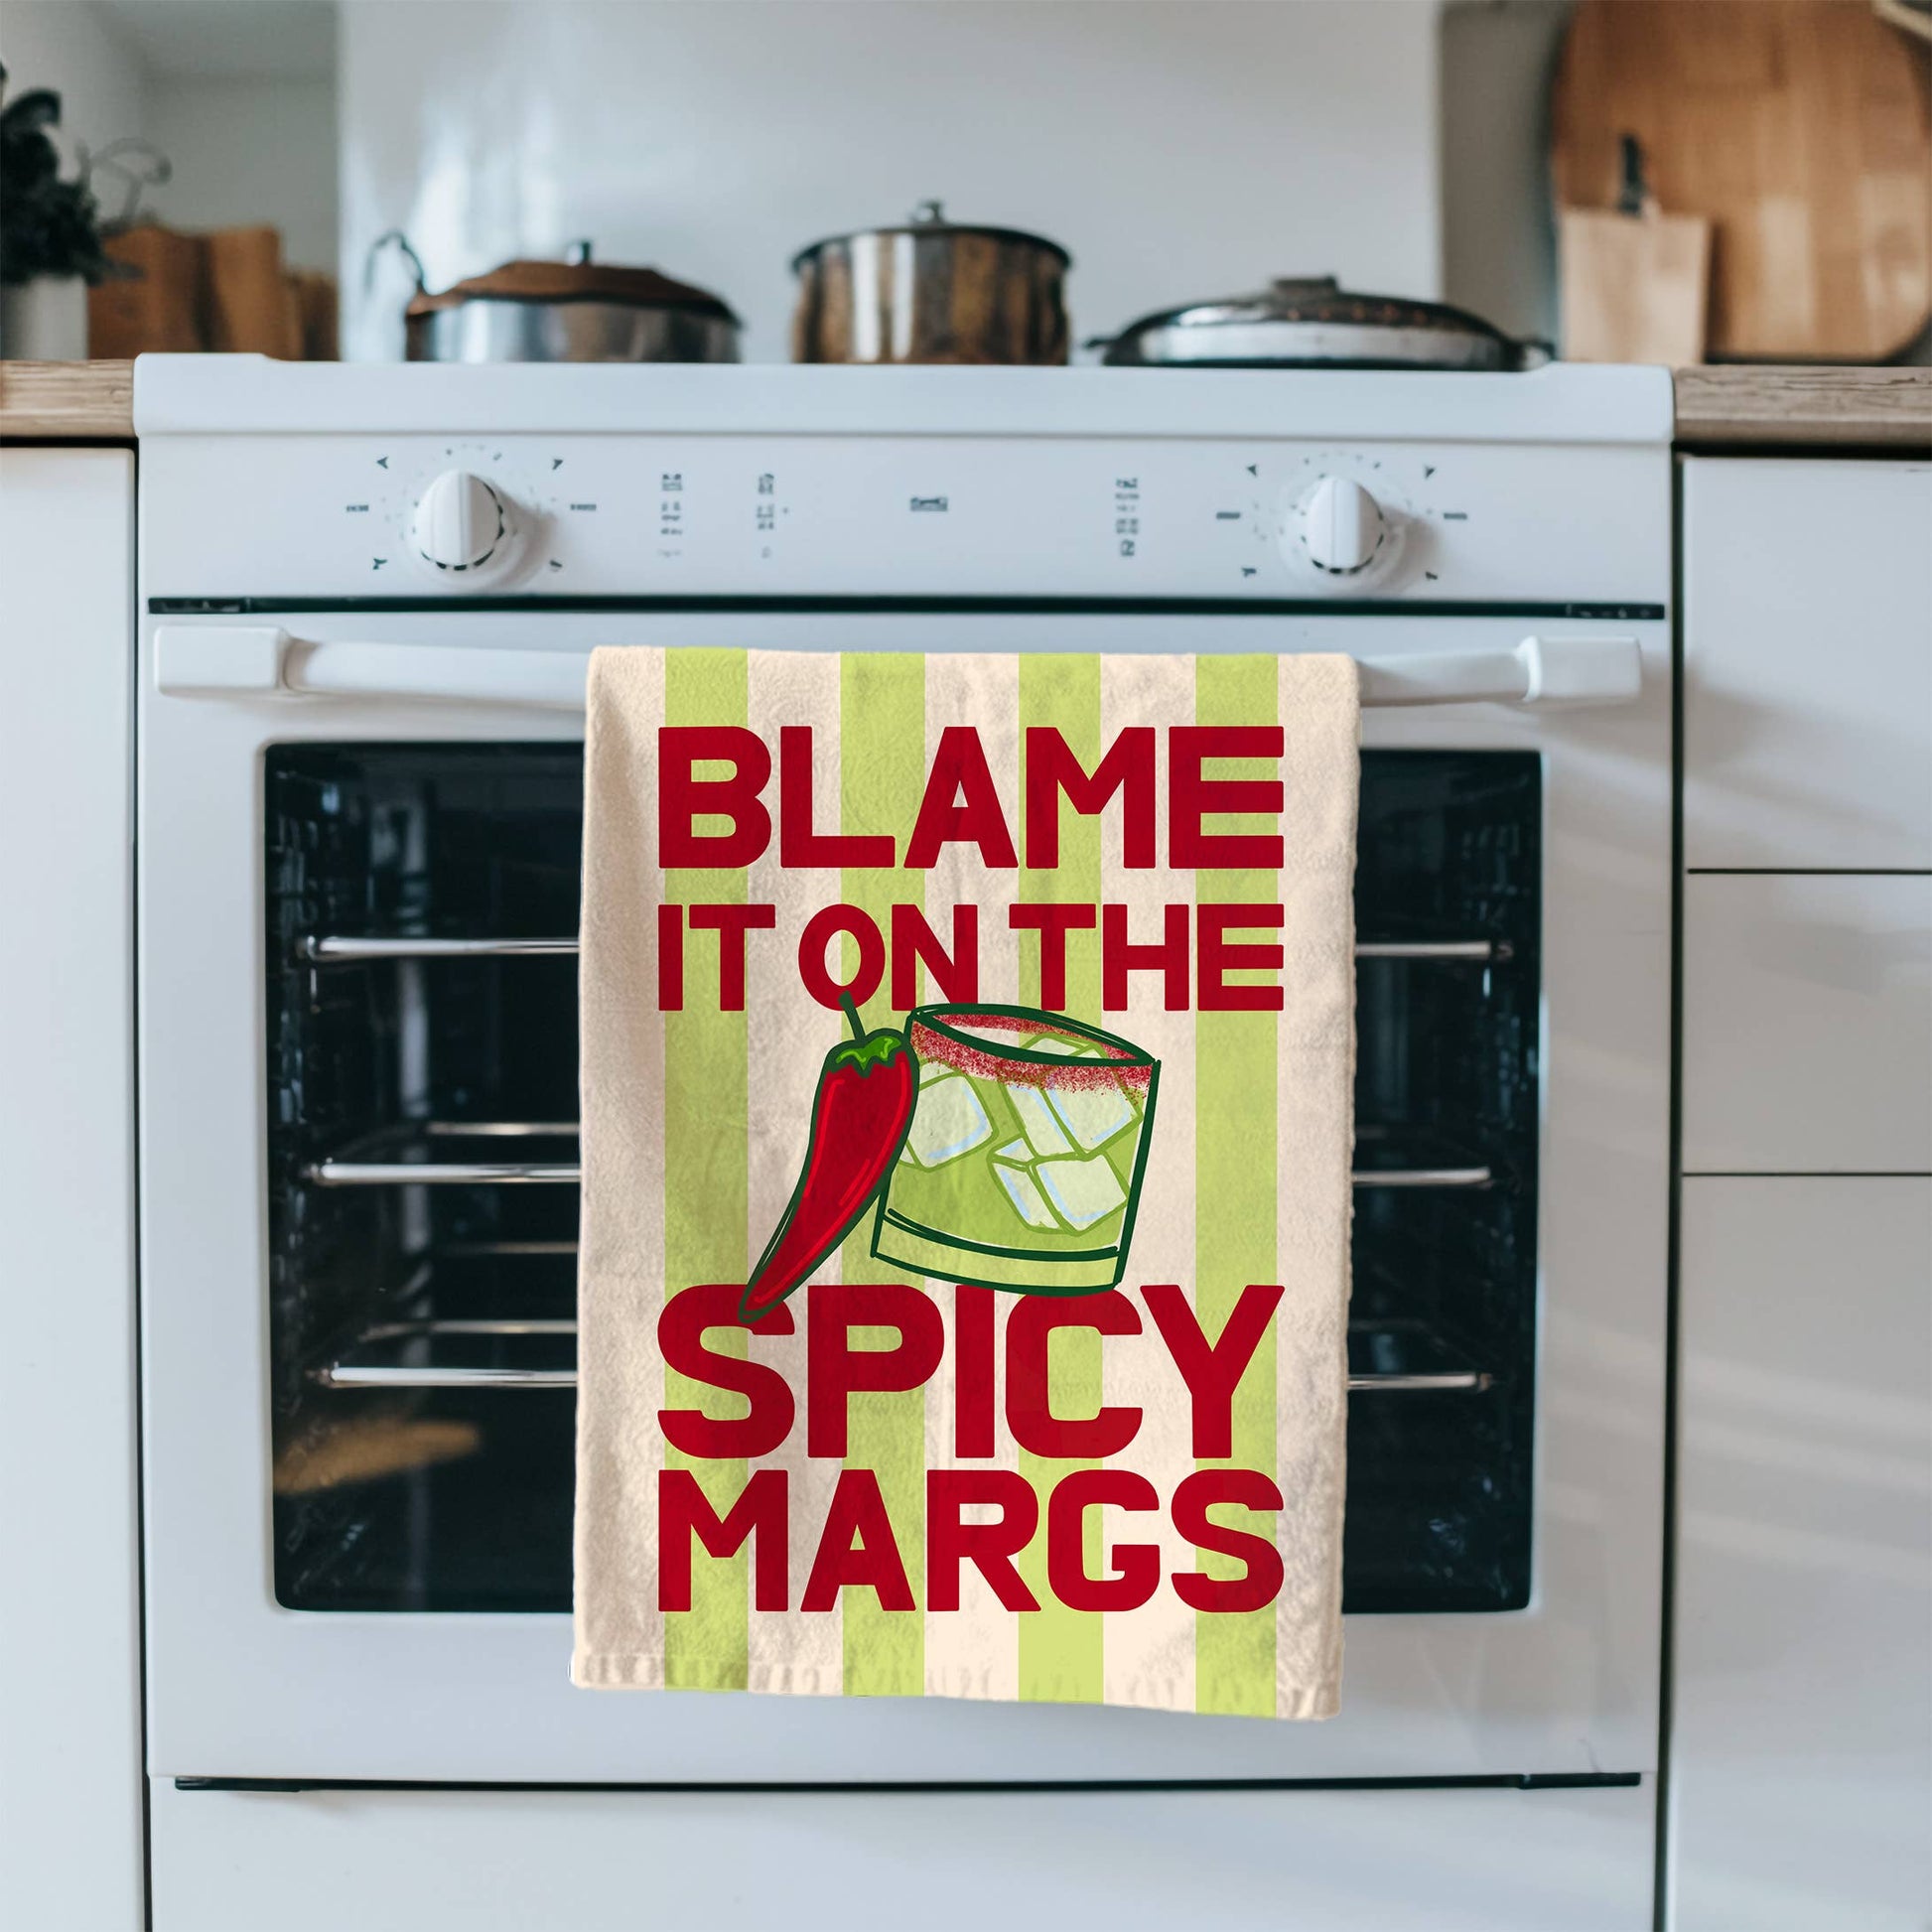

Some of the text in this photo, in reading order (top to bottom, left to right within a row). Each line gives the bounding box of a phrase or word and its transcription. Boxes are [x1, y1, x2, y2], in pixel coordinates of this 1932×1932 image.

[658, 726, 1285, 870] BLAME
[657, 903, 1285, 1012] IT ON THE
[657, 1284, 1286, 1459] SPICY
[658, 1469, 1285, 1613] MARGS
